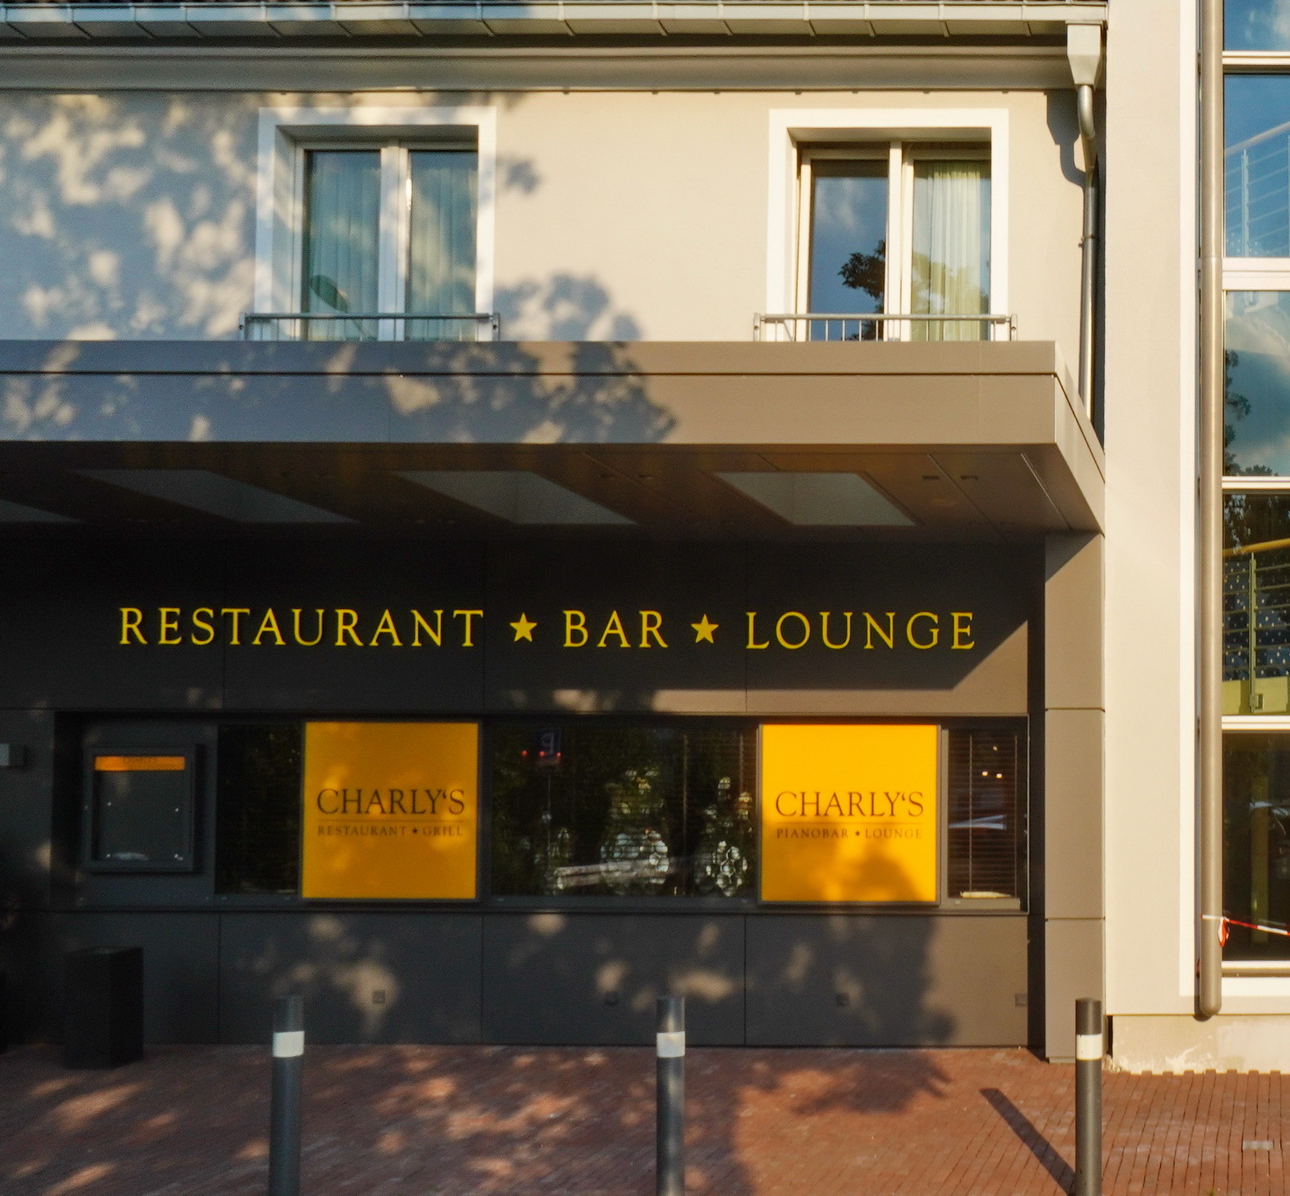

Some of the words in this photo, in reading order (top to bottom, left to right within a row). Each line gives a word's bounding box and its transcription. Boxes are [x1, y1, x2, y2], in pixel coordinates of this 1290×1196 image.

[119, 607, 484, 647] RESTAURANT
[562, 609, 669, 648] BAR
[746, 611, 976, 650] LOUNGE
[317, 825, 407, 837] RESTAURANT
[422, 825, 464, 837] GRILL
[776, 828, 849, 839] PIANOBAR
[865, 828, 922, 839] LOUNGE
